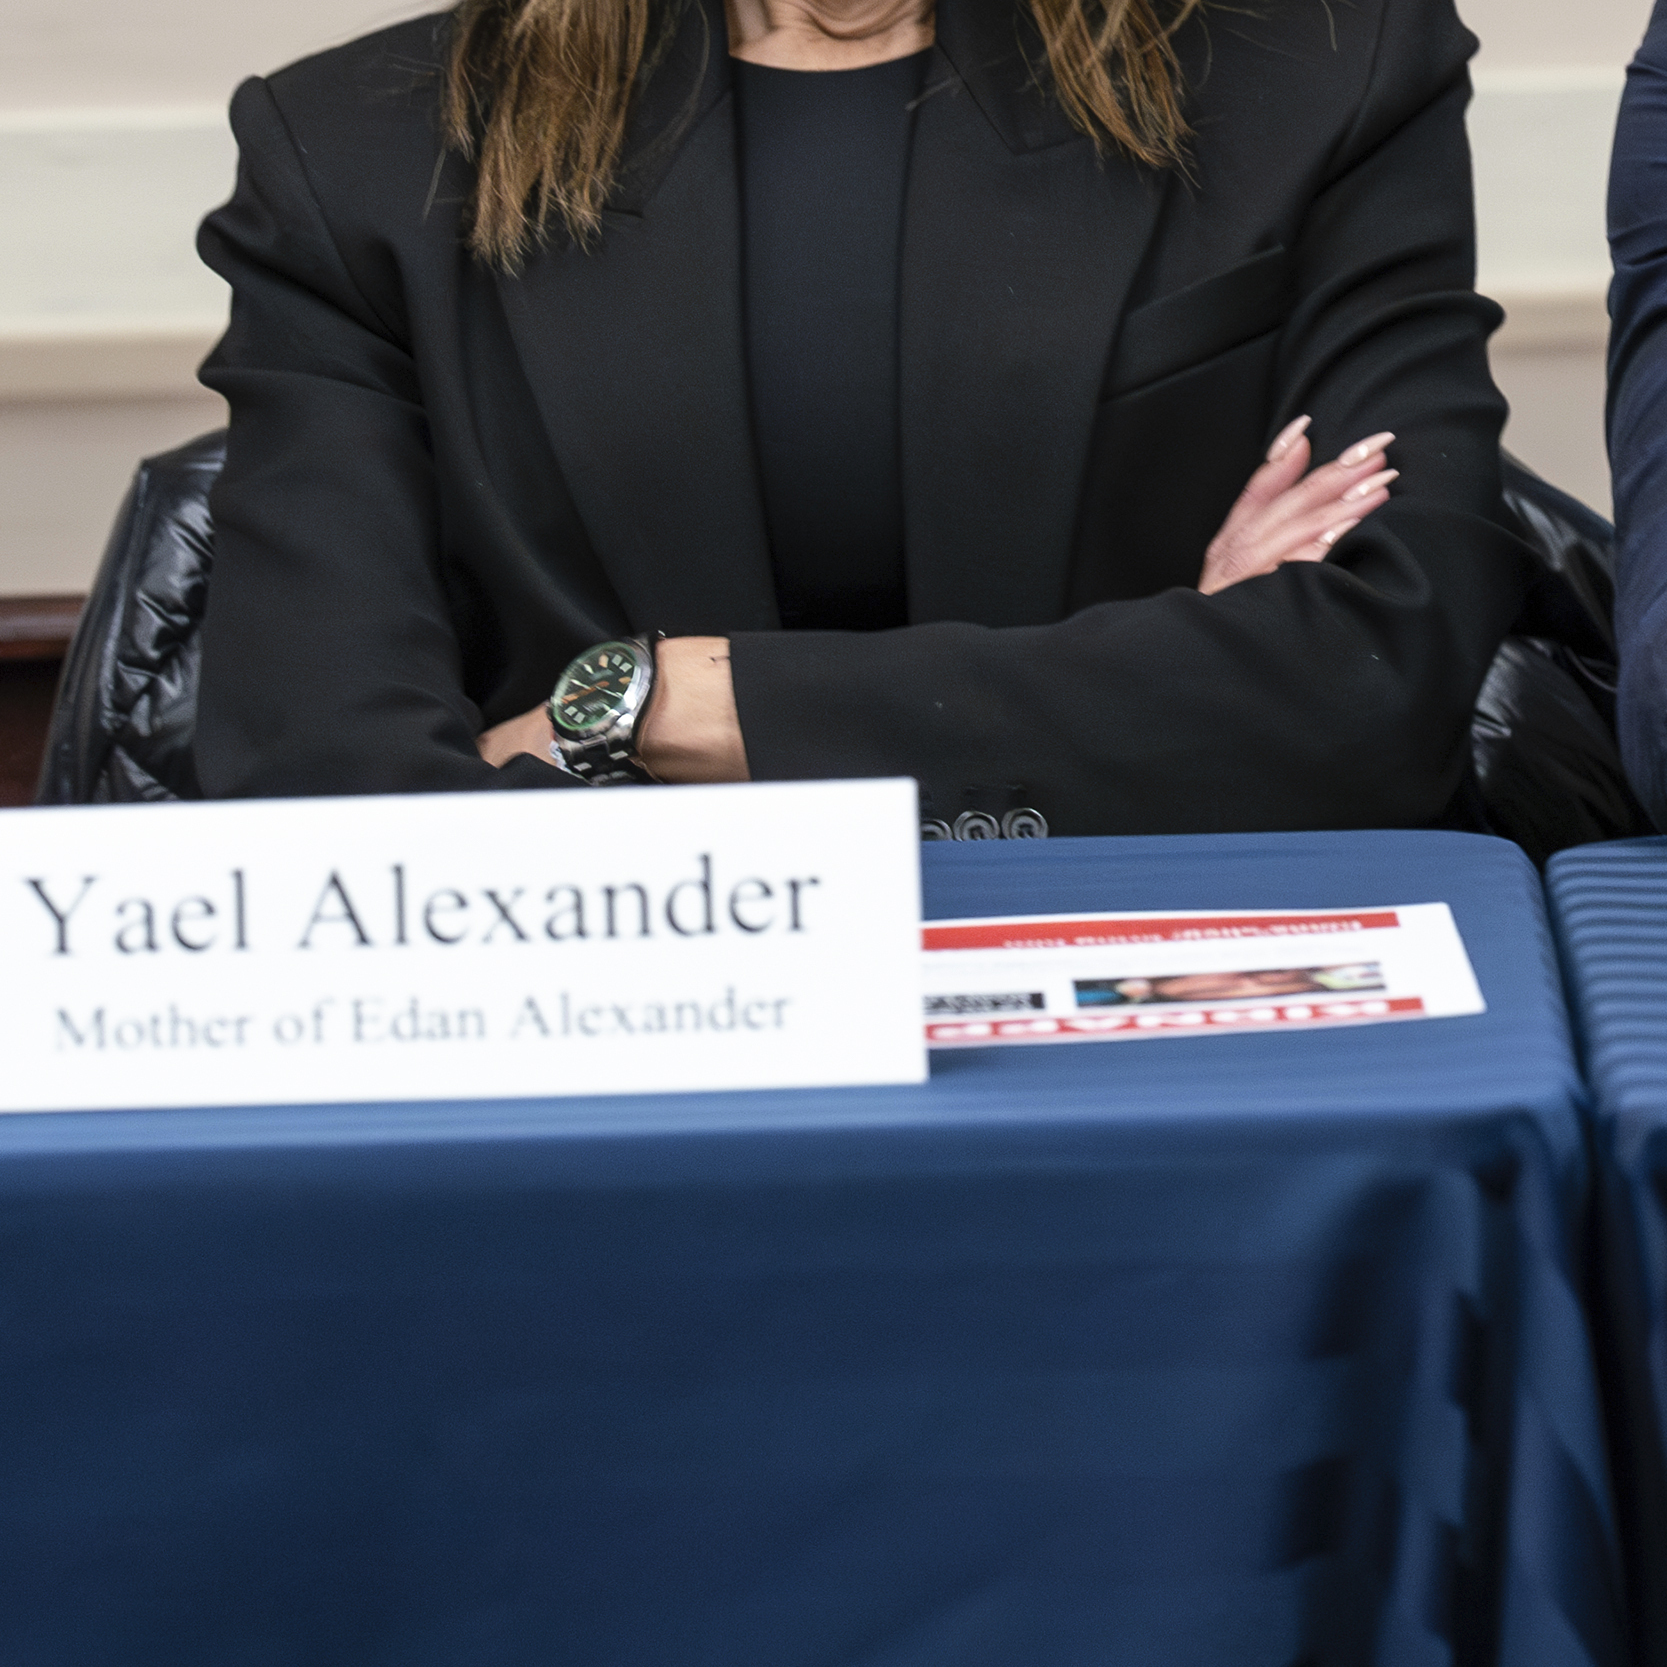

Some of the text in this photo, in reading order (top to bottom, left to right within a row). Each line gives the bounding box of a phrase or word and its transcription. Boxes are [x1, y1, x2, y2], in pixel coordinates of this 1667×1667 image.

[23, 852, 821, 958] Yael Alexander
[56, 986, 788, 1050] Mother of Edan Alexander
